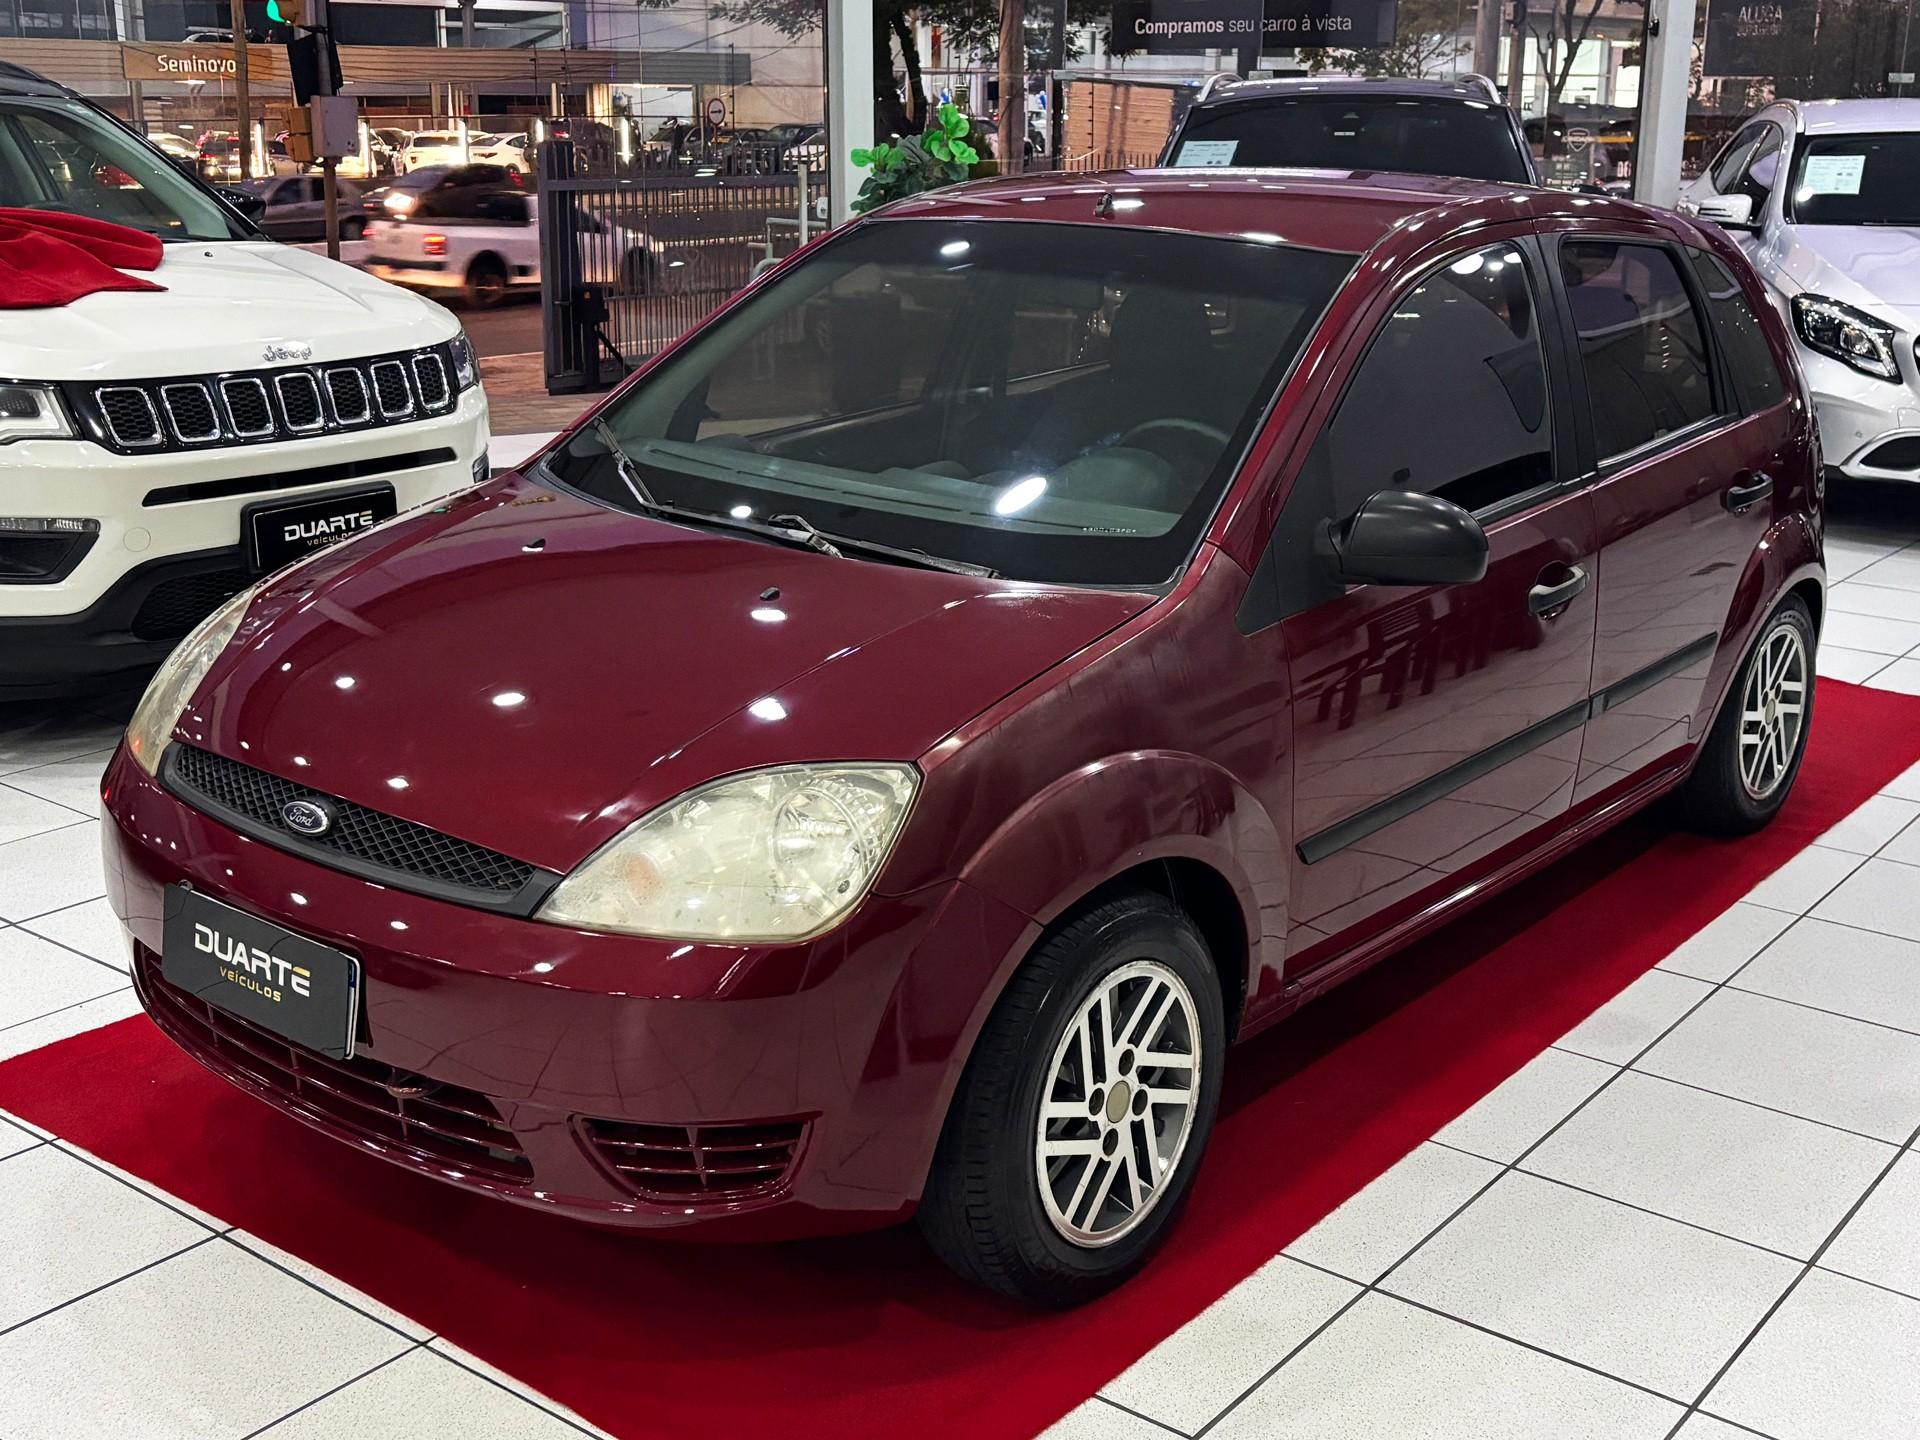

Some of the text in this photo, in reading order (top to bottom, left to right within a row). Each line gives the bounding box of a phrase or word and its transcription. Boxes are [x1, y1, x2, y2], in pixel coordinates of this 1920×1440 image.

[1135, 13, 1352, 38] Compramos seu carro à vista
[157, 54, 237, 73] Seminovo
[262, 344, 312, 361] Jeep
[283, 510, 373, 541] DUARTE
[289, 806, 315, 827] Ford
[194, 922, 311, 997] DUARTE
